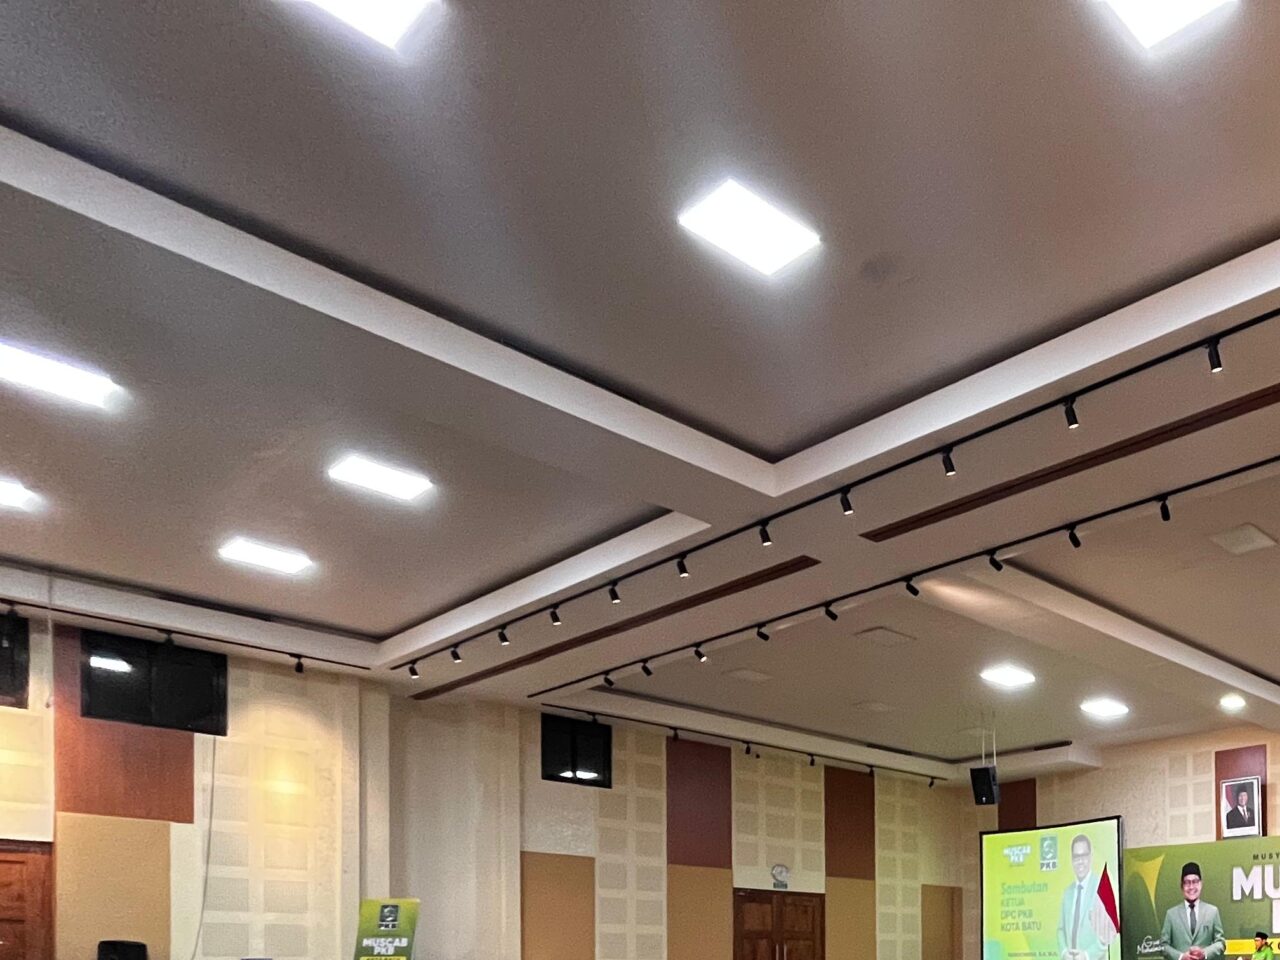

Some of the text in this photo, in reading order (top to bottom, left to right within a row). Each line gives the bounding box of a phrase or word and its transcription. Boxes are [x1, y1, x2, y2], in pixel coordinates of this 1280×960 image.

[1001, 880, 1048, 895] Sambutan
[1001, 920, 1042, 932] KOTA BATU
[362, 937, 408, 947] MUSCAB
